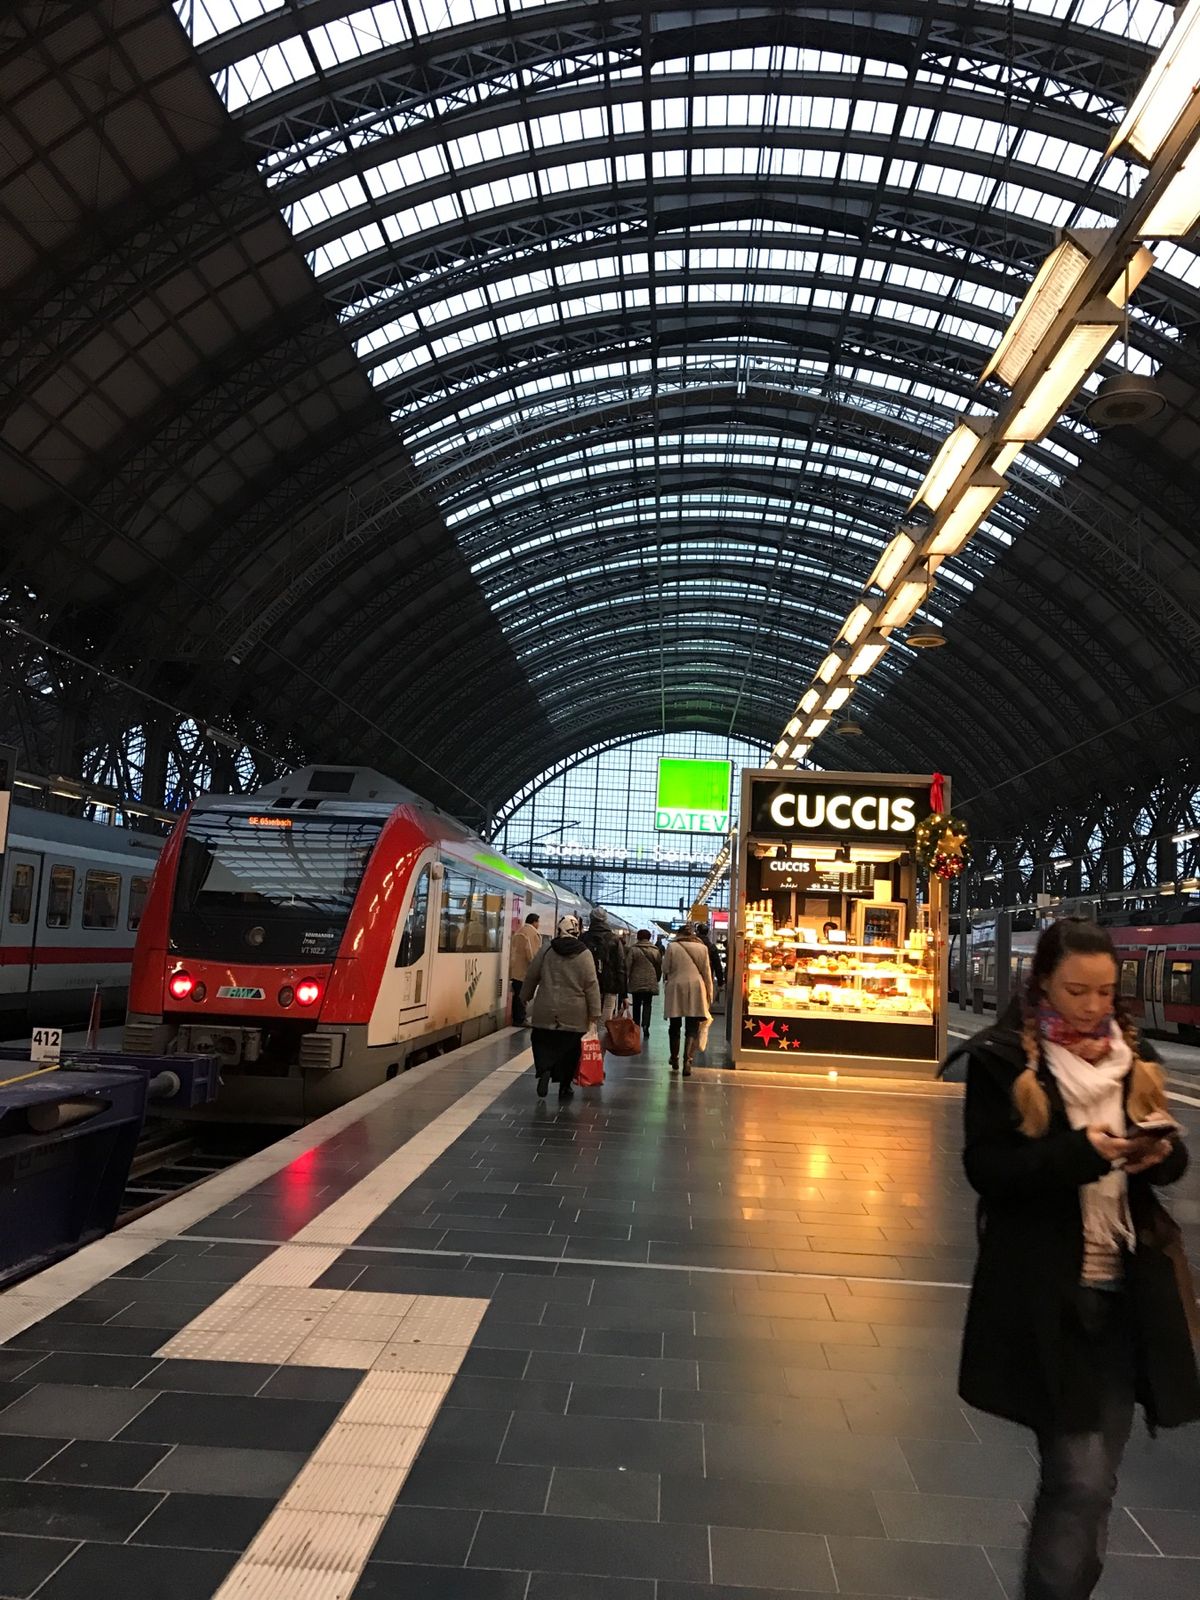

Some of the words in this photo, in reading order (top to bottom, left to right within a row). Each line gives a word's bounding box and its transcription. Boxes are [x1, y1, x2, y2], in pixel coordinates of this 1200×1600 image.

[656, 811, 728, 832] DATEV
[770, 793, 916, 832] CUCCIS
[653, 844, 719, 864] Servic
[770, 861, 810, 873] CUCCIS
[33, 1030, 60, 1047] 412
